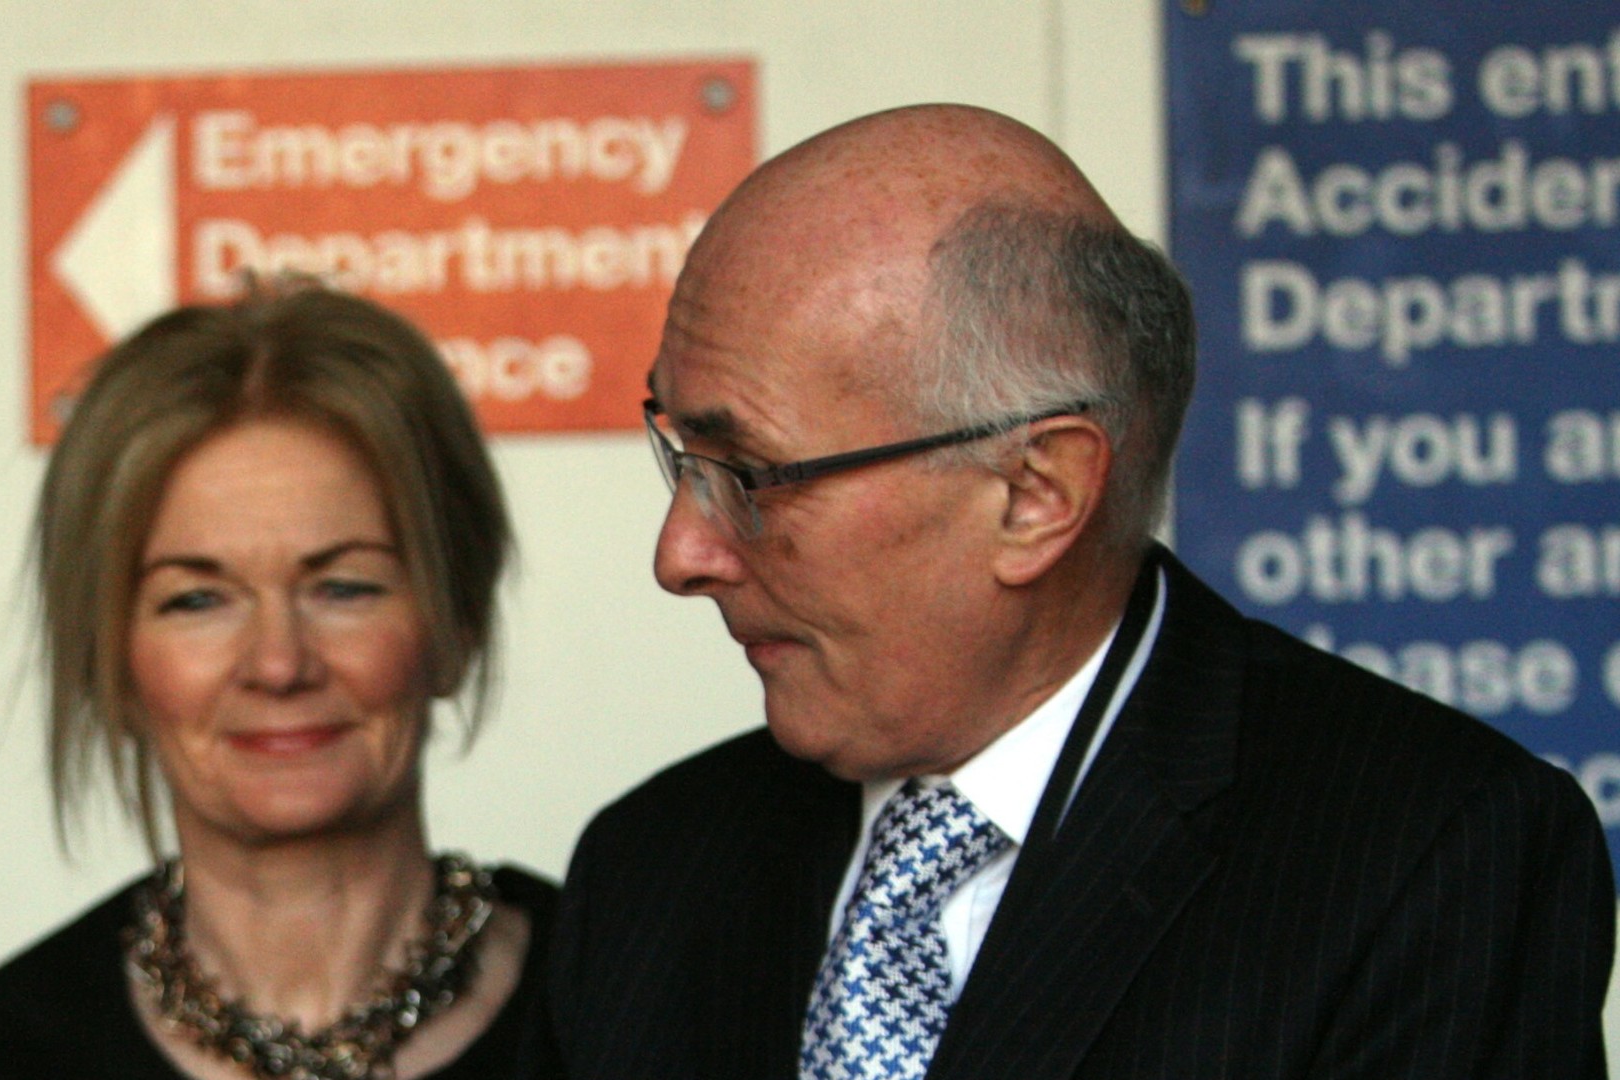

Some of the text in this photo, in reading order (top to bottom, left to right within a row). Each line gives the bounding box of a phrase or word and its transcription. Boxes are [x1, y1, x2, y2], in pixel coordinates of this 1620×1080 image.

[1234, 30, 1453, 121] This
[192, 112, 686, 199] Emergency
[1237, 396, 1620, 503] If you a
[1236, 511, 1513, 603] other
